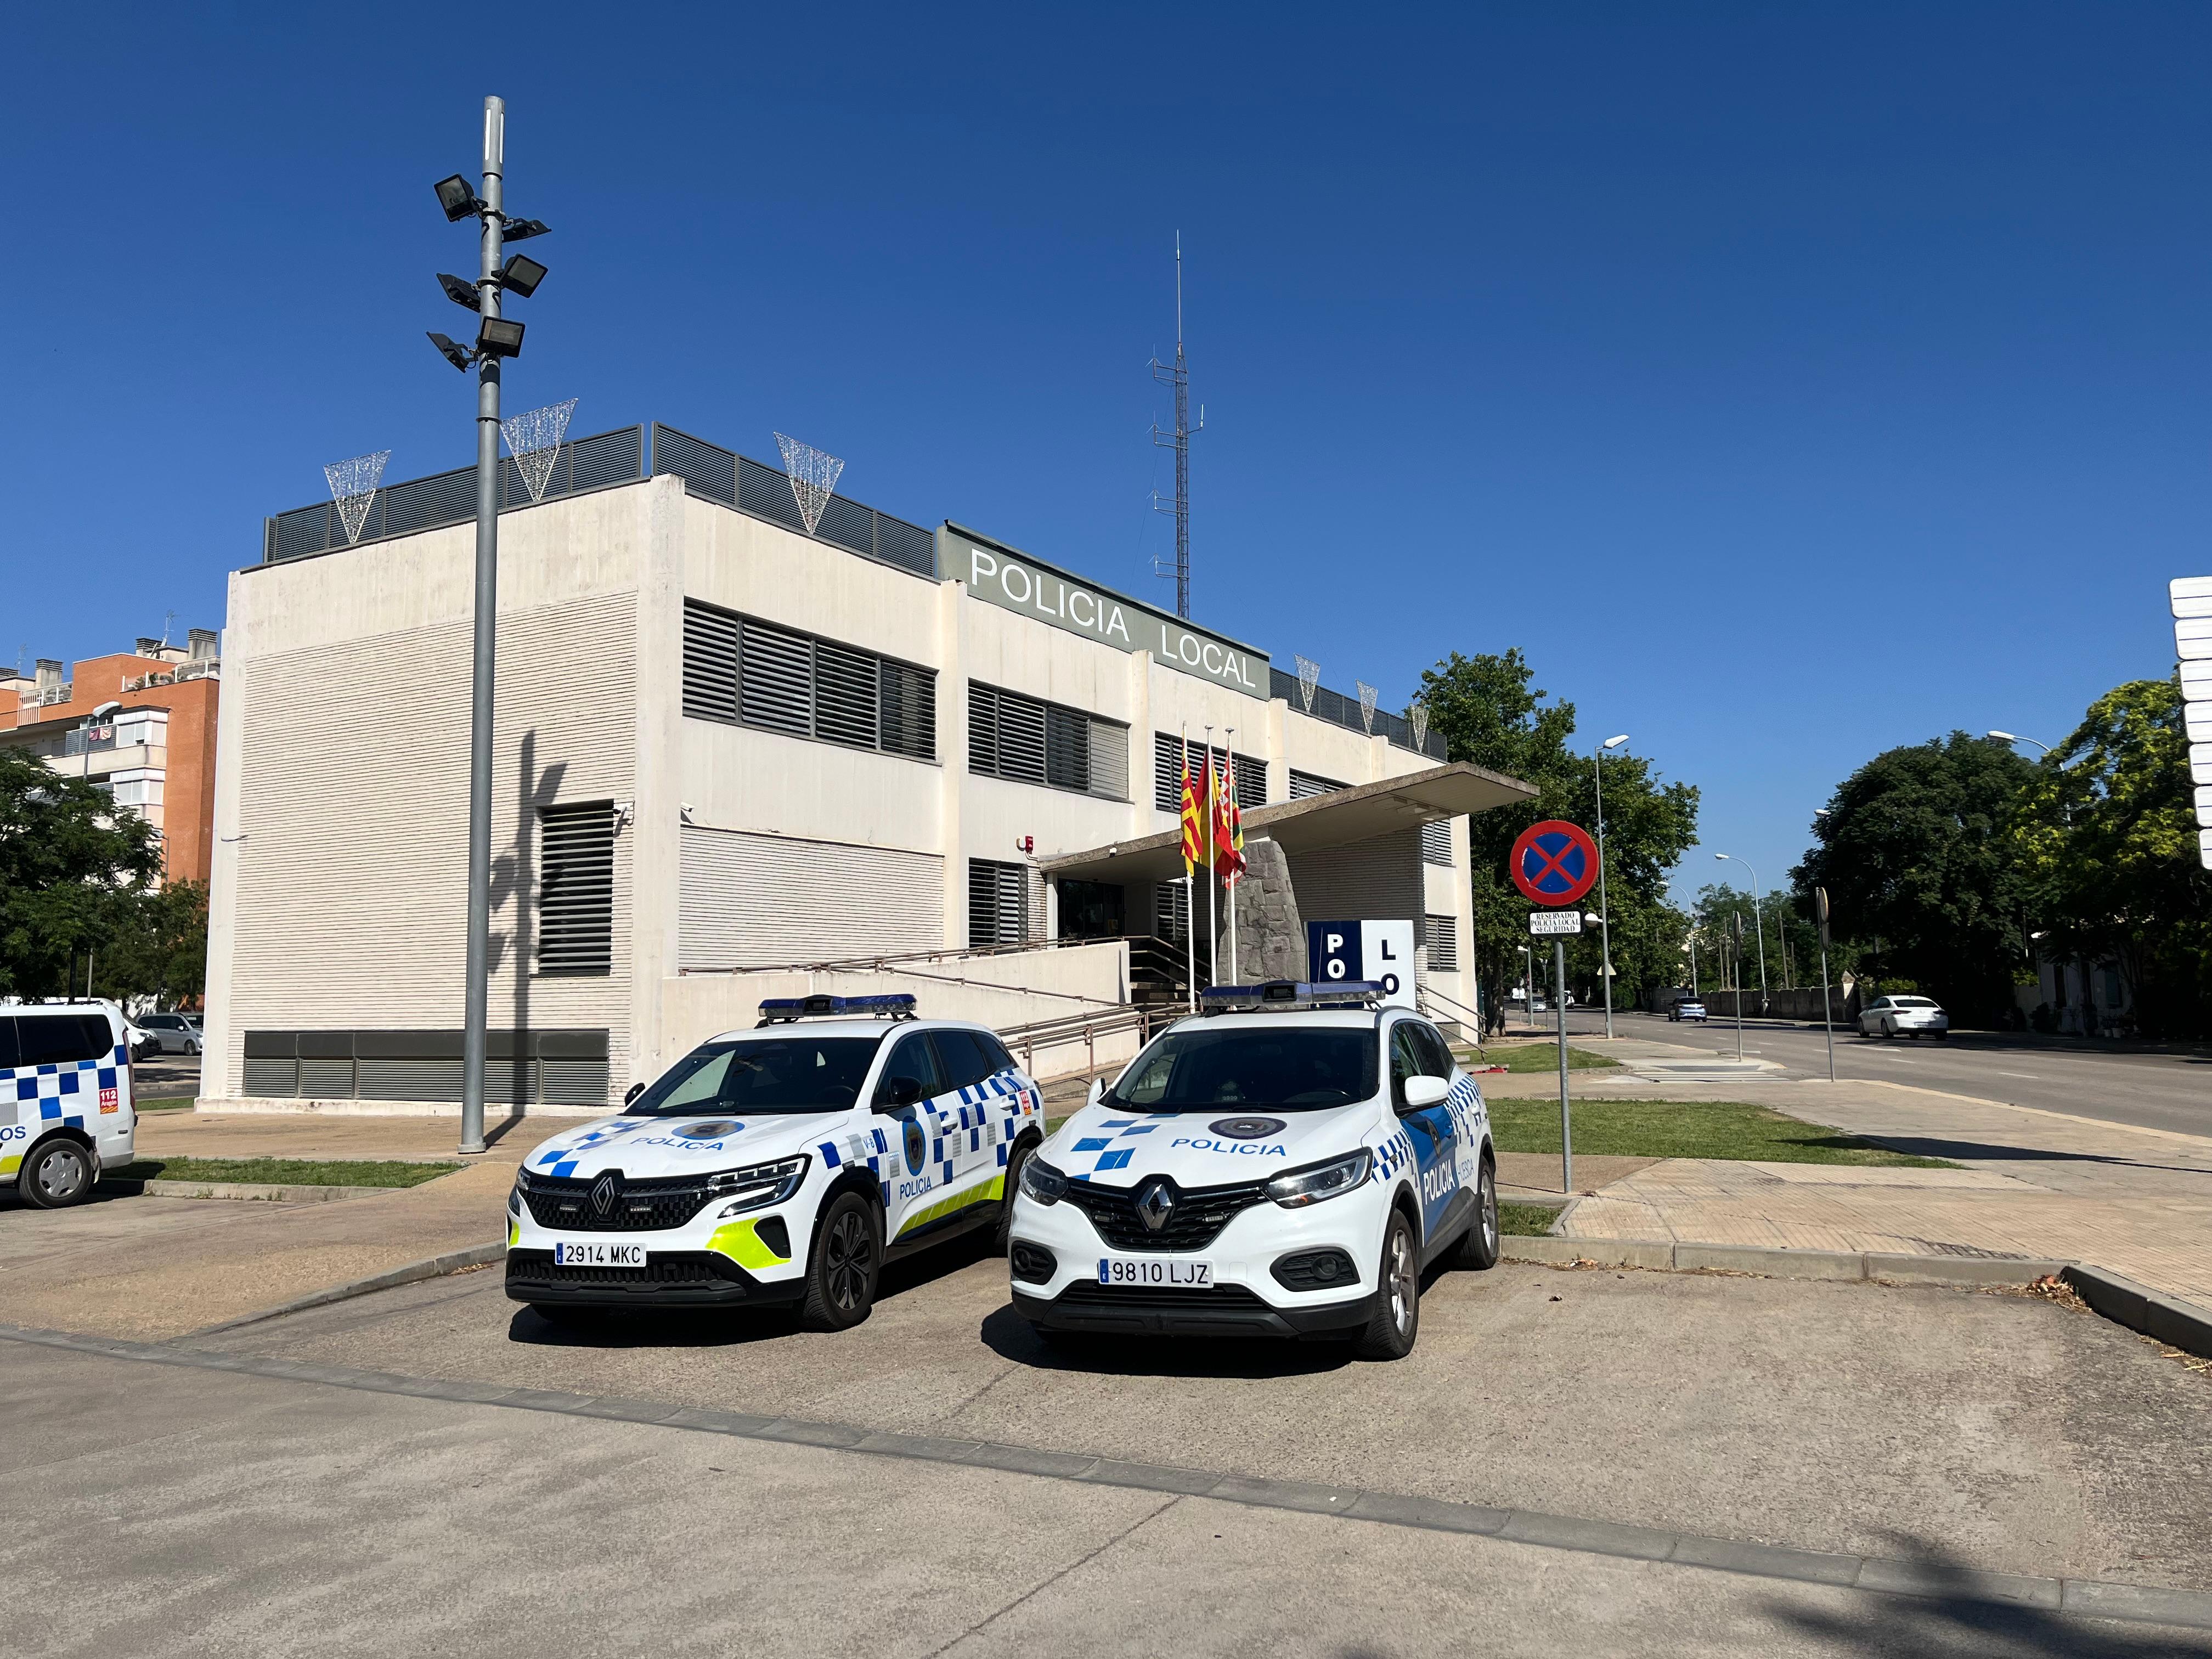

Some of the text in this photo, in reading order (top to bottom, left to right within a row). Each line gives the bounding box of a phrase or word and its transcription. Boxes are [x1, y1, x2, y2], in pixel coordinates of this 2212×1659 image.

[971, 548, 1256, 688] POLICIA LOCAL
[100, 1090, 117, 1101] 112
[862, 1136, 874, 1149] V-8
[1171, 1138, 1286, 1156] POLICIA
[1457, 1158, 1475, 1182] HUESCA
[900, 1176, 932, 1200] POLICIA
[1423, 1159, 1455, 1205] POLICIA
[566, 1245, 605, 1263] 2914
[611, 1246, 640, 1263] MKC
[1113, 1262, 1163, 1282] 9810
[1170, 1263, 1208, 1284] LJZ
